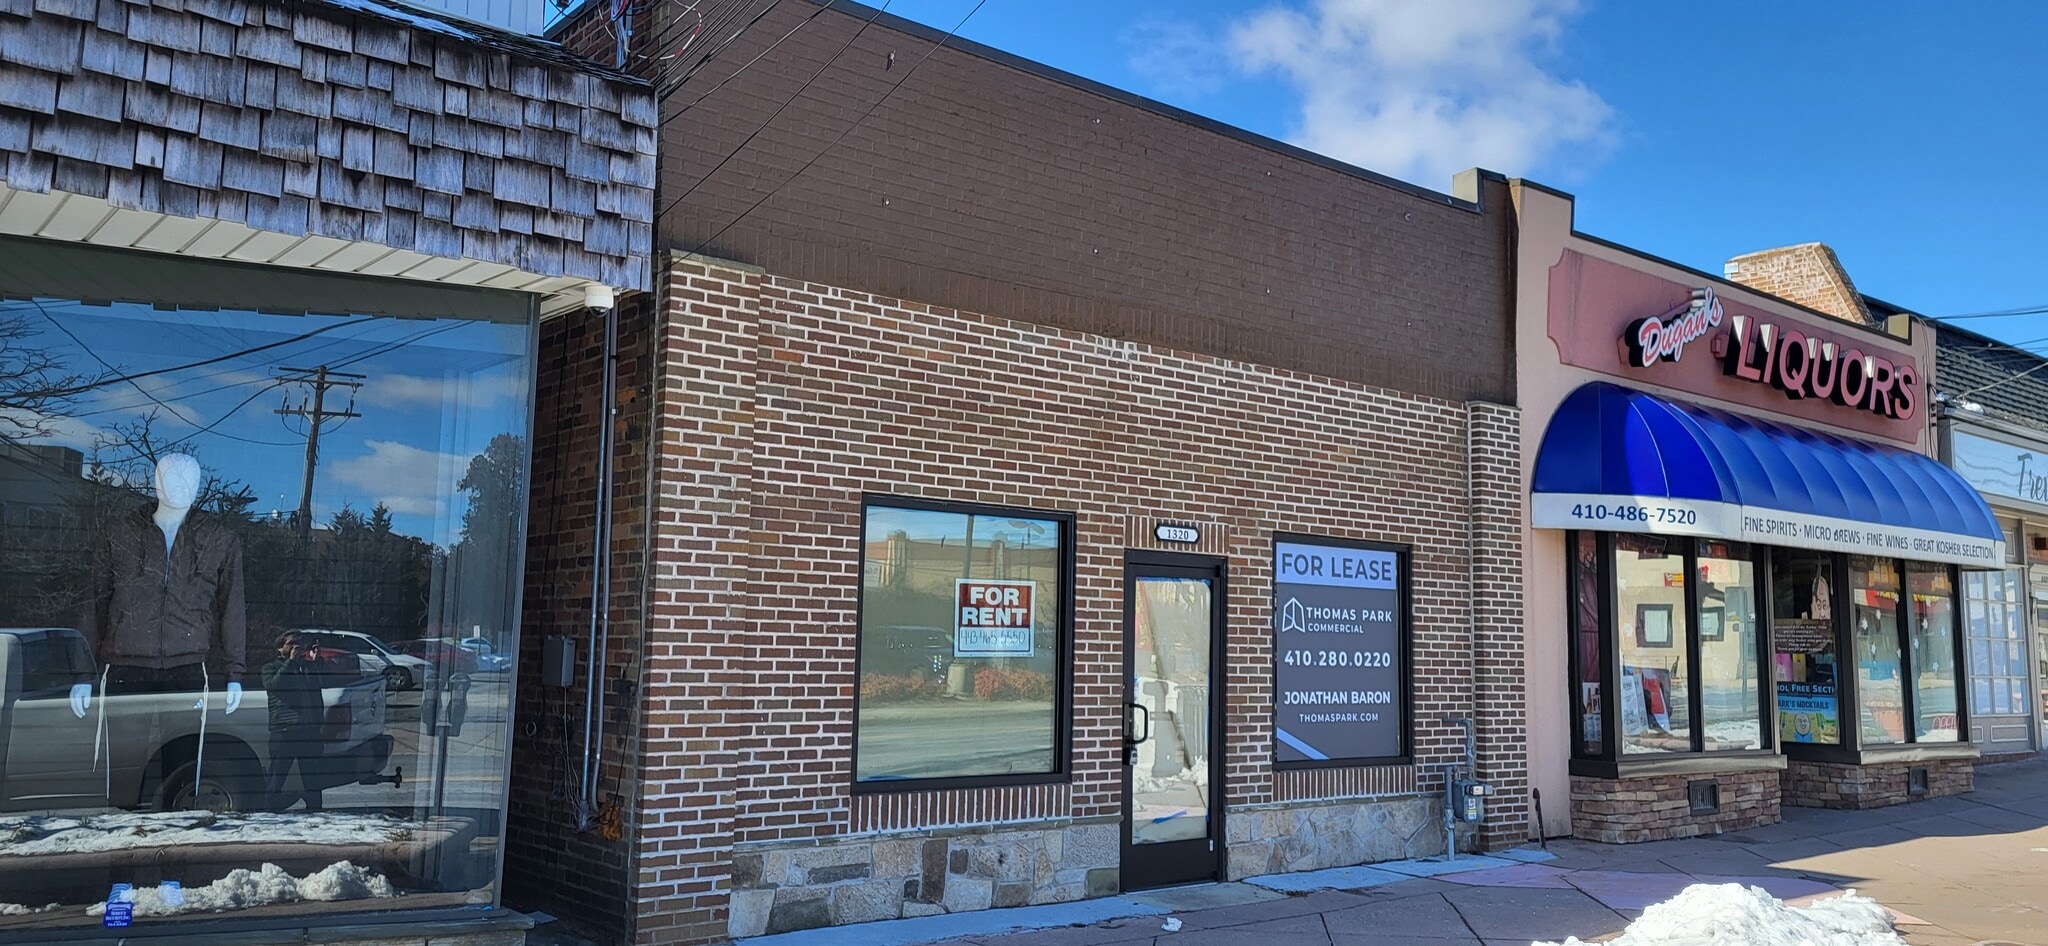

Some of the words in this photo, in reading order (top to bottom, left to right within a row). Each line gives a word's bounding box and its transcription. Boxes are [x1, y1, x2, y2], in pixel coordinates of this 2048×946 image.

[1638, 286, 1723, 367] Dugan's
[1735, 315, 1918, 421] LIQUORS
[1571, 503, 1697, 525] 410-486-7520
[1167, 529, 1189, 540] 1320
[1744, 516, 1764, 533] FINE
[1766, 519, 1798, 537] SPIRITS
[1804, 524, 1831, 541] MICRO
[1833, 529, 1861, 544] BREWS
[1866, 532, 1883, 547] FINE
[1885, 535, 1909, 550] WINES
[1913, 538, 1935, 553] GREAT
[1936, 541, 1961, 556] KOSHER
[1962, 544, 1994, 560] SELECTION
[1281, 553, 1323, 577] FOR
[1331, 556, 1392, 581] LEASE
[970, 586, 1019, 606] FOR
[961, 606, 1028, 626] RENT
[1306, 606, 1357, 621] THOMAS
[1362, 609, 1392, 622] PARK
[1307, 623, 1365, 634] COMMERCIAL
[1284, 650, 1391, 667] 410.280.0220
[1791, 683, 1811, 693] FREE
[1284, 691, 1348, 705] JONATHAN
[1351, 691, 1391, 704] BARON
[1796, 700, 1829, 710] MOCKTAILS
[1299, 712, 1379, 723] THOMASPARK.COM
